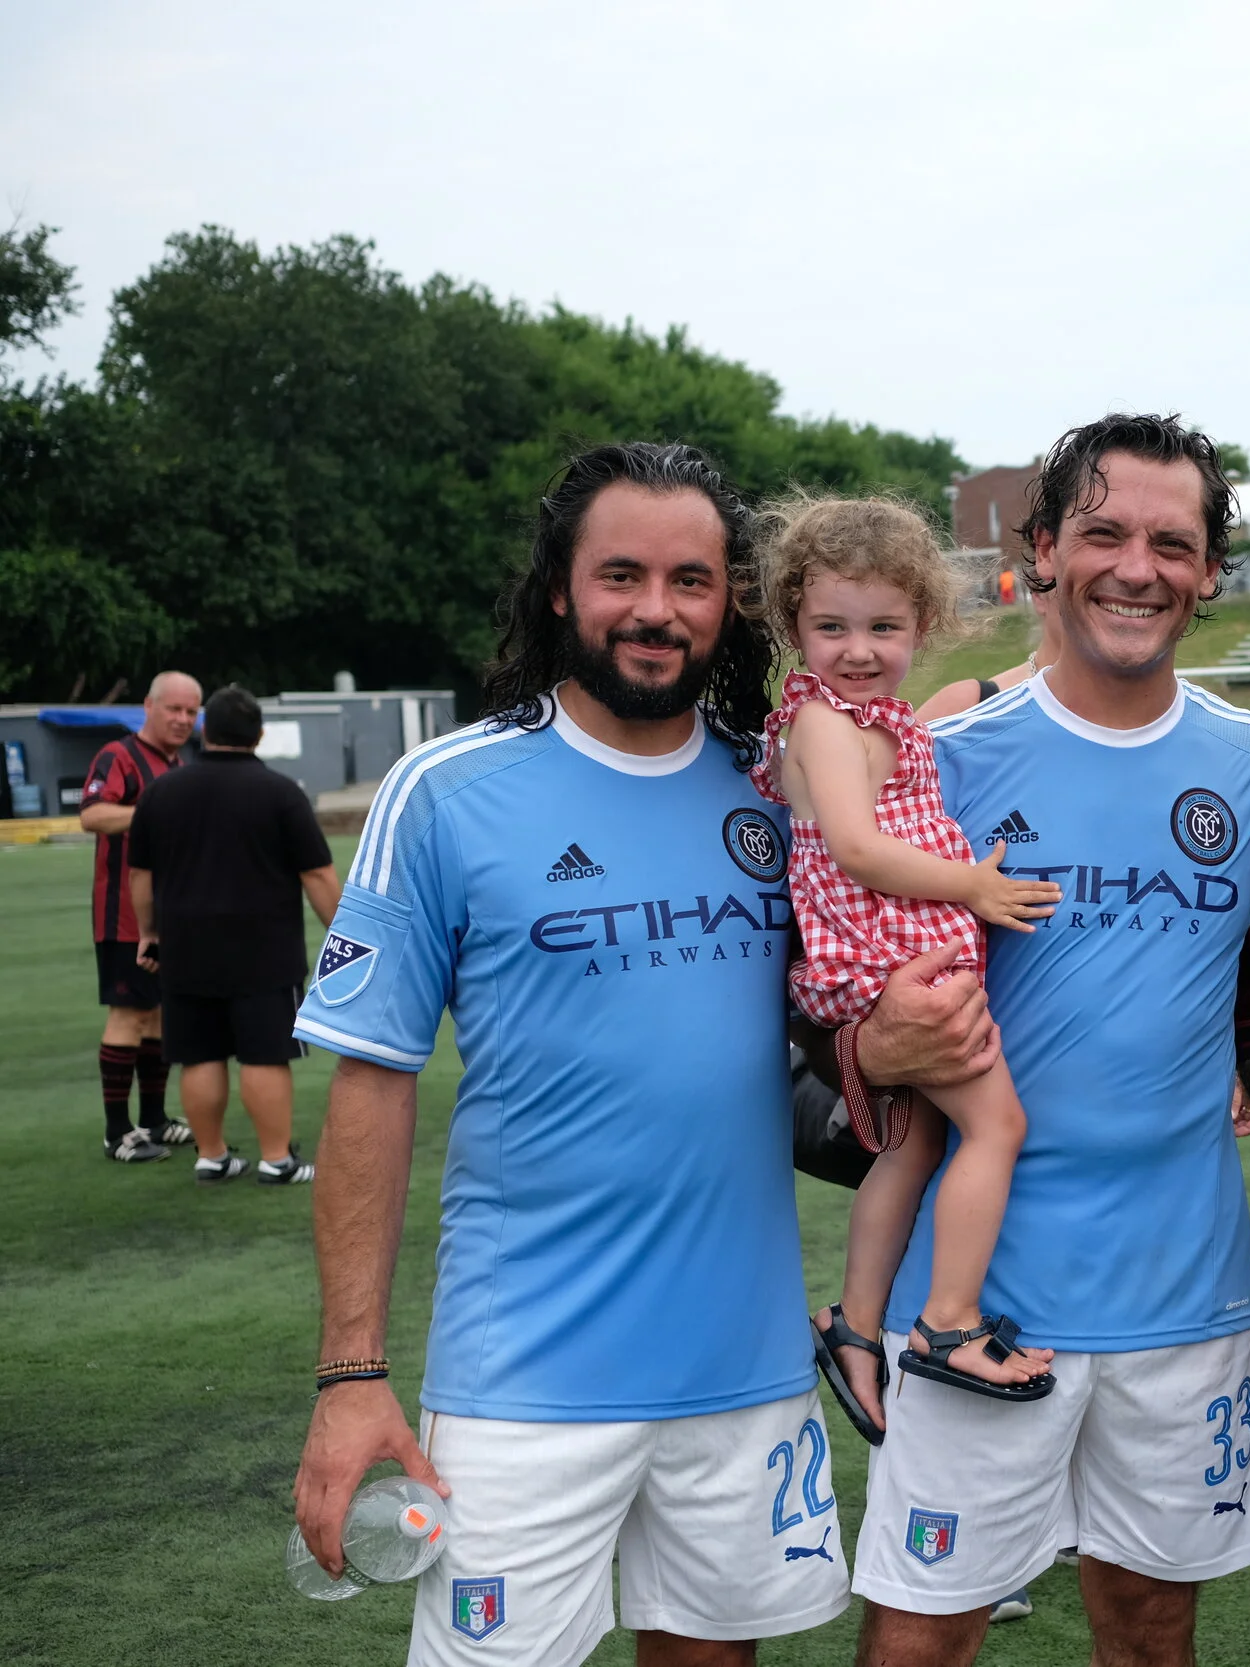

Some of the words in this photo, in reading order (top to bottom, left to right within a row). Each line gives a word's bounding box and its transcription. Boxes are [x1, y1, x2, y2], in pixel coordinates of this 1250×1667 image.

[1197, 795, 1213, 803] YORK
[546, 865, 605, 882] adidas
[998, 864, 1239, 913] TIHAD
[530, 892, 792, 953] ETIHAD
[1042, 911, 1201, 935] IRWAYS
[327, 936, 354, 958] MLS
[584, 940, 772, 976] AIRWAYS
[768, 1418, 835, 1536] 22
[920, 1520, 945, 1529] ITALIA
[463, 1587, 491, 1597] ITALIA
